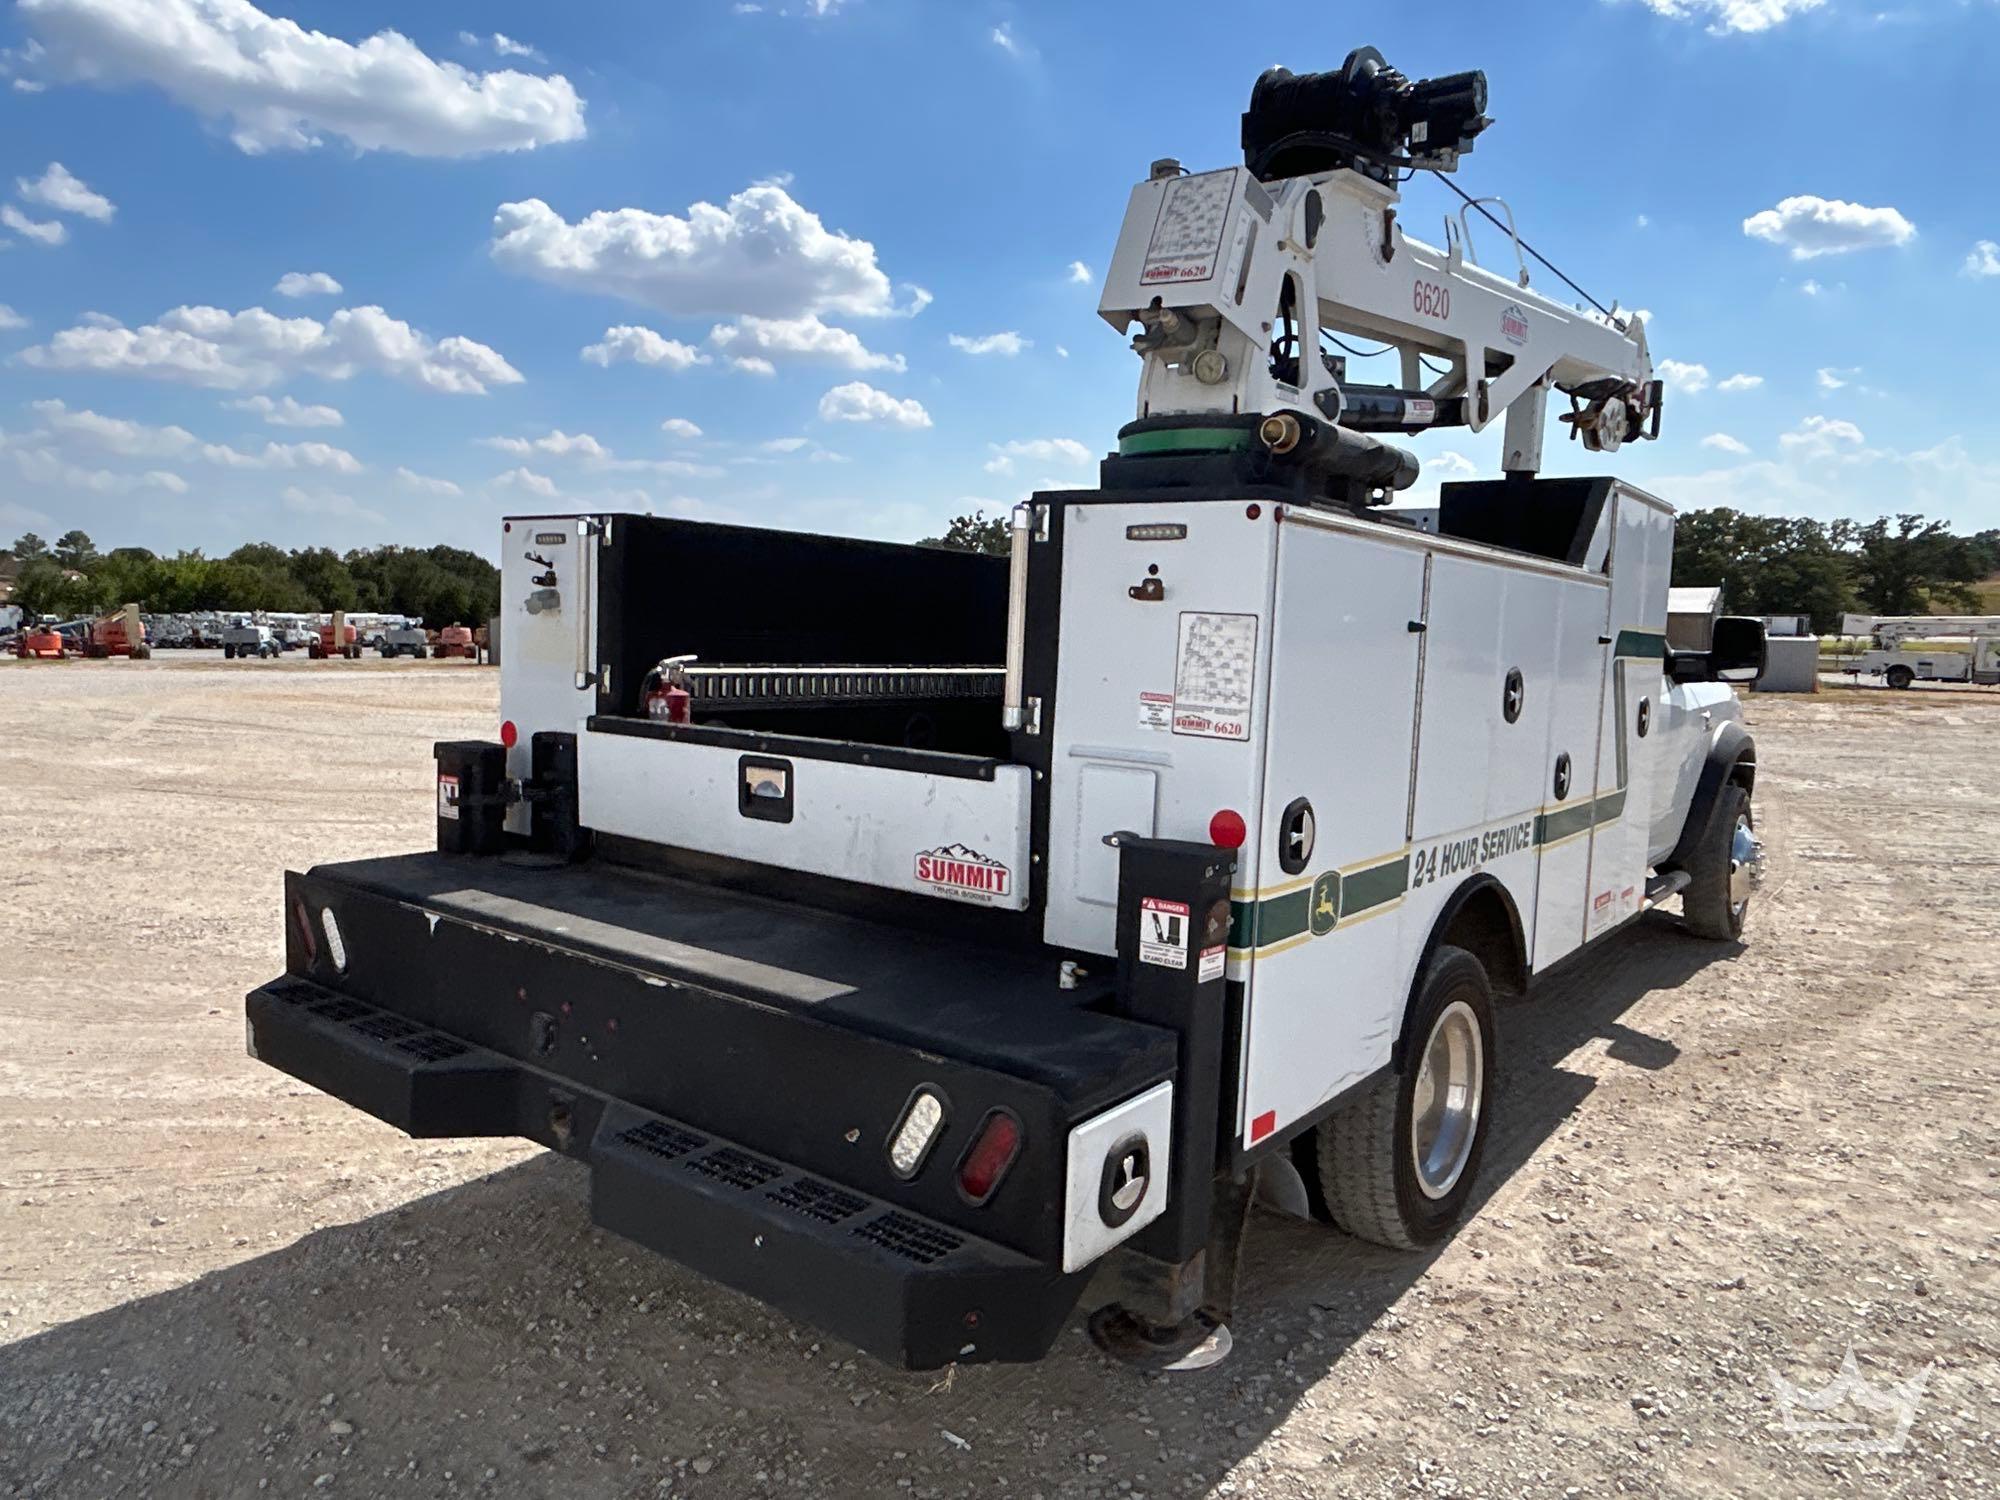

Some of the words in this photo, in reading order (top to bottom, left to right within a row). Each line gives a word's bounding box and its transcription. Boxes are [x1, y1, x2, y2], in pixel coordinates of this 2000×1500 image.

[1180, 265, 1207, 278] 6620
[1413, 279, 1450, 320] 6620
[1175, 718, 1211, 730] SUMMIT
[1214, 722, 1242, 736] 6620
[1413, 845, 1438, 889] 24
[1440, 837, 1479, 877] HOUR
[1480, 821, 1532, 863] SERVICE
[918, 857, 1007, 892] SUMMIT
[1158, 902, 1184, 913] DANGER
